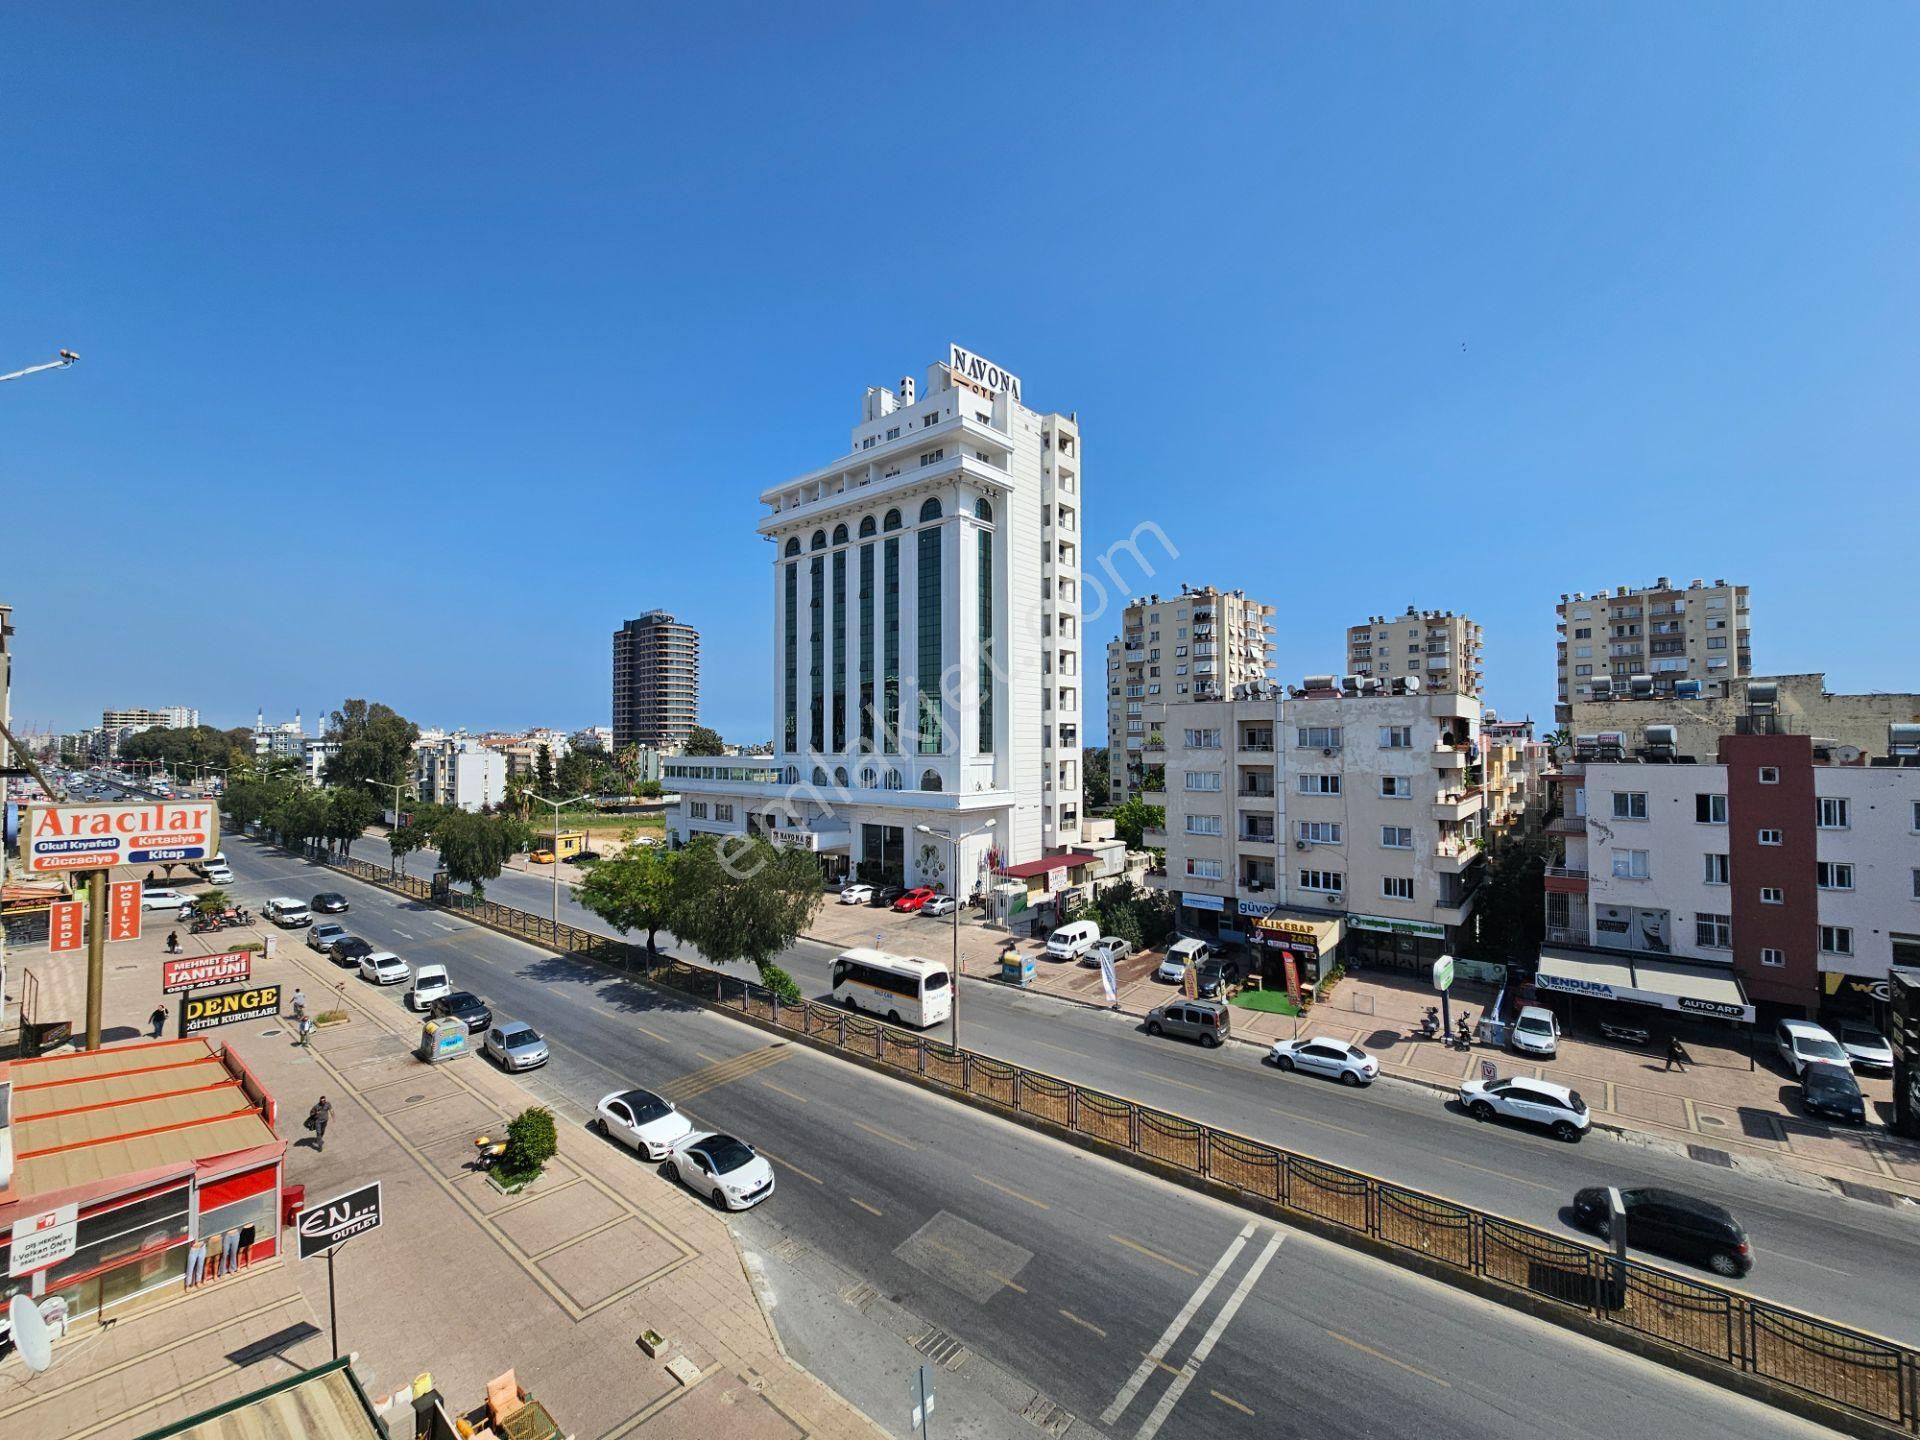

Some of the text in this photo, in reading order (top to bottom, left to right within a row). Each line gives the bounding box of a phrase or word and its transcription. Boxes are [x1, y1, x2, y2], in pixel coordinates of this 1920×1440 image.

[953, 348, 1019, 399] NAVONA
[35, 804, 207, 836] Aracılar
[38, 838, 117, 852] Okul Kıyafeti
[138, 834, 197, 846] Kırtasiye
[41, 854, 114, 868] Züccaciye
[148, 849, 186, 861] Kitap
[119, 885, 133, 937] MOBİLYA
[60, 906, 73, 948] PERDE
[175, 954, 241, 970] MEHMET ŞEF
[169, 960, 246, 983] TANTUNİ
[1550, 976, 1612, 993] ENDURA
[187, 988, 277, 1019] DENGE
[1683, 998, 1716, 1011] AUTO
[1716, 1004, 1741, 1015] ART
[222, 1007, 277, 1022] KURUMLARI
[332, 1216, 377, 1240] OUTLET
